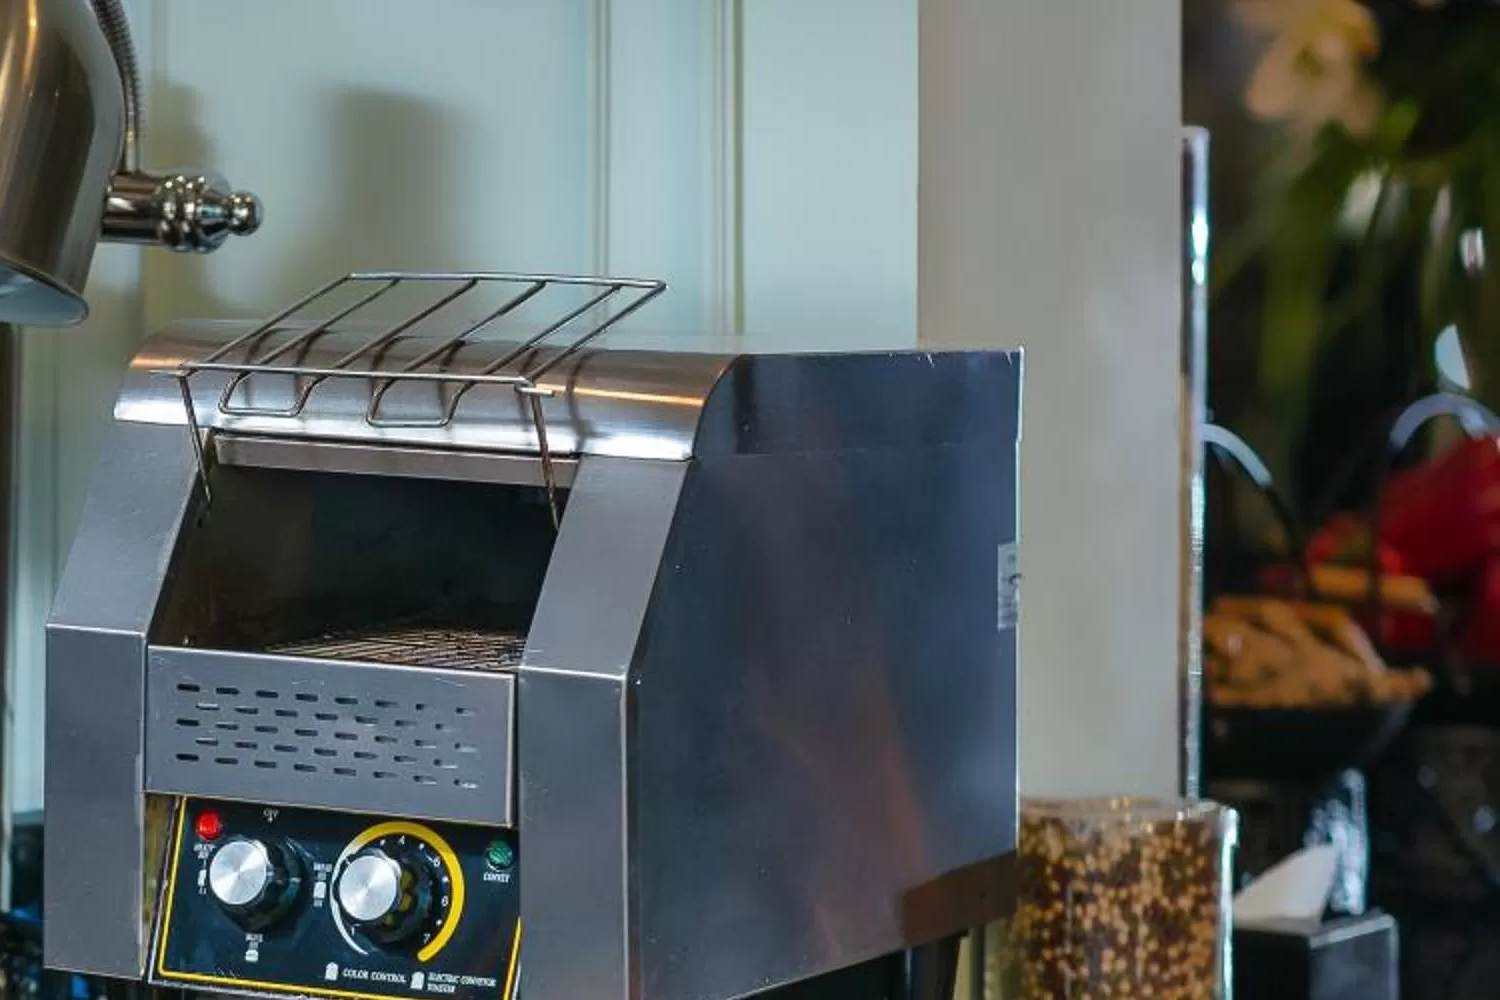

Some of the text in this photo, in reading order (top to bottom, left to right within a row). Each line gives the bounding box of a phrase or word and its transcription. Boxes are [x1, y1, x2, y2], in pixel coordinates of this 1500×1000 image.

[441, 895, 449, 907] 6
[423, 933, 431, 944] 7
[342, 967, 407, 983] COLOR CONTROL
